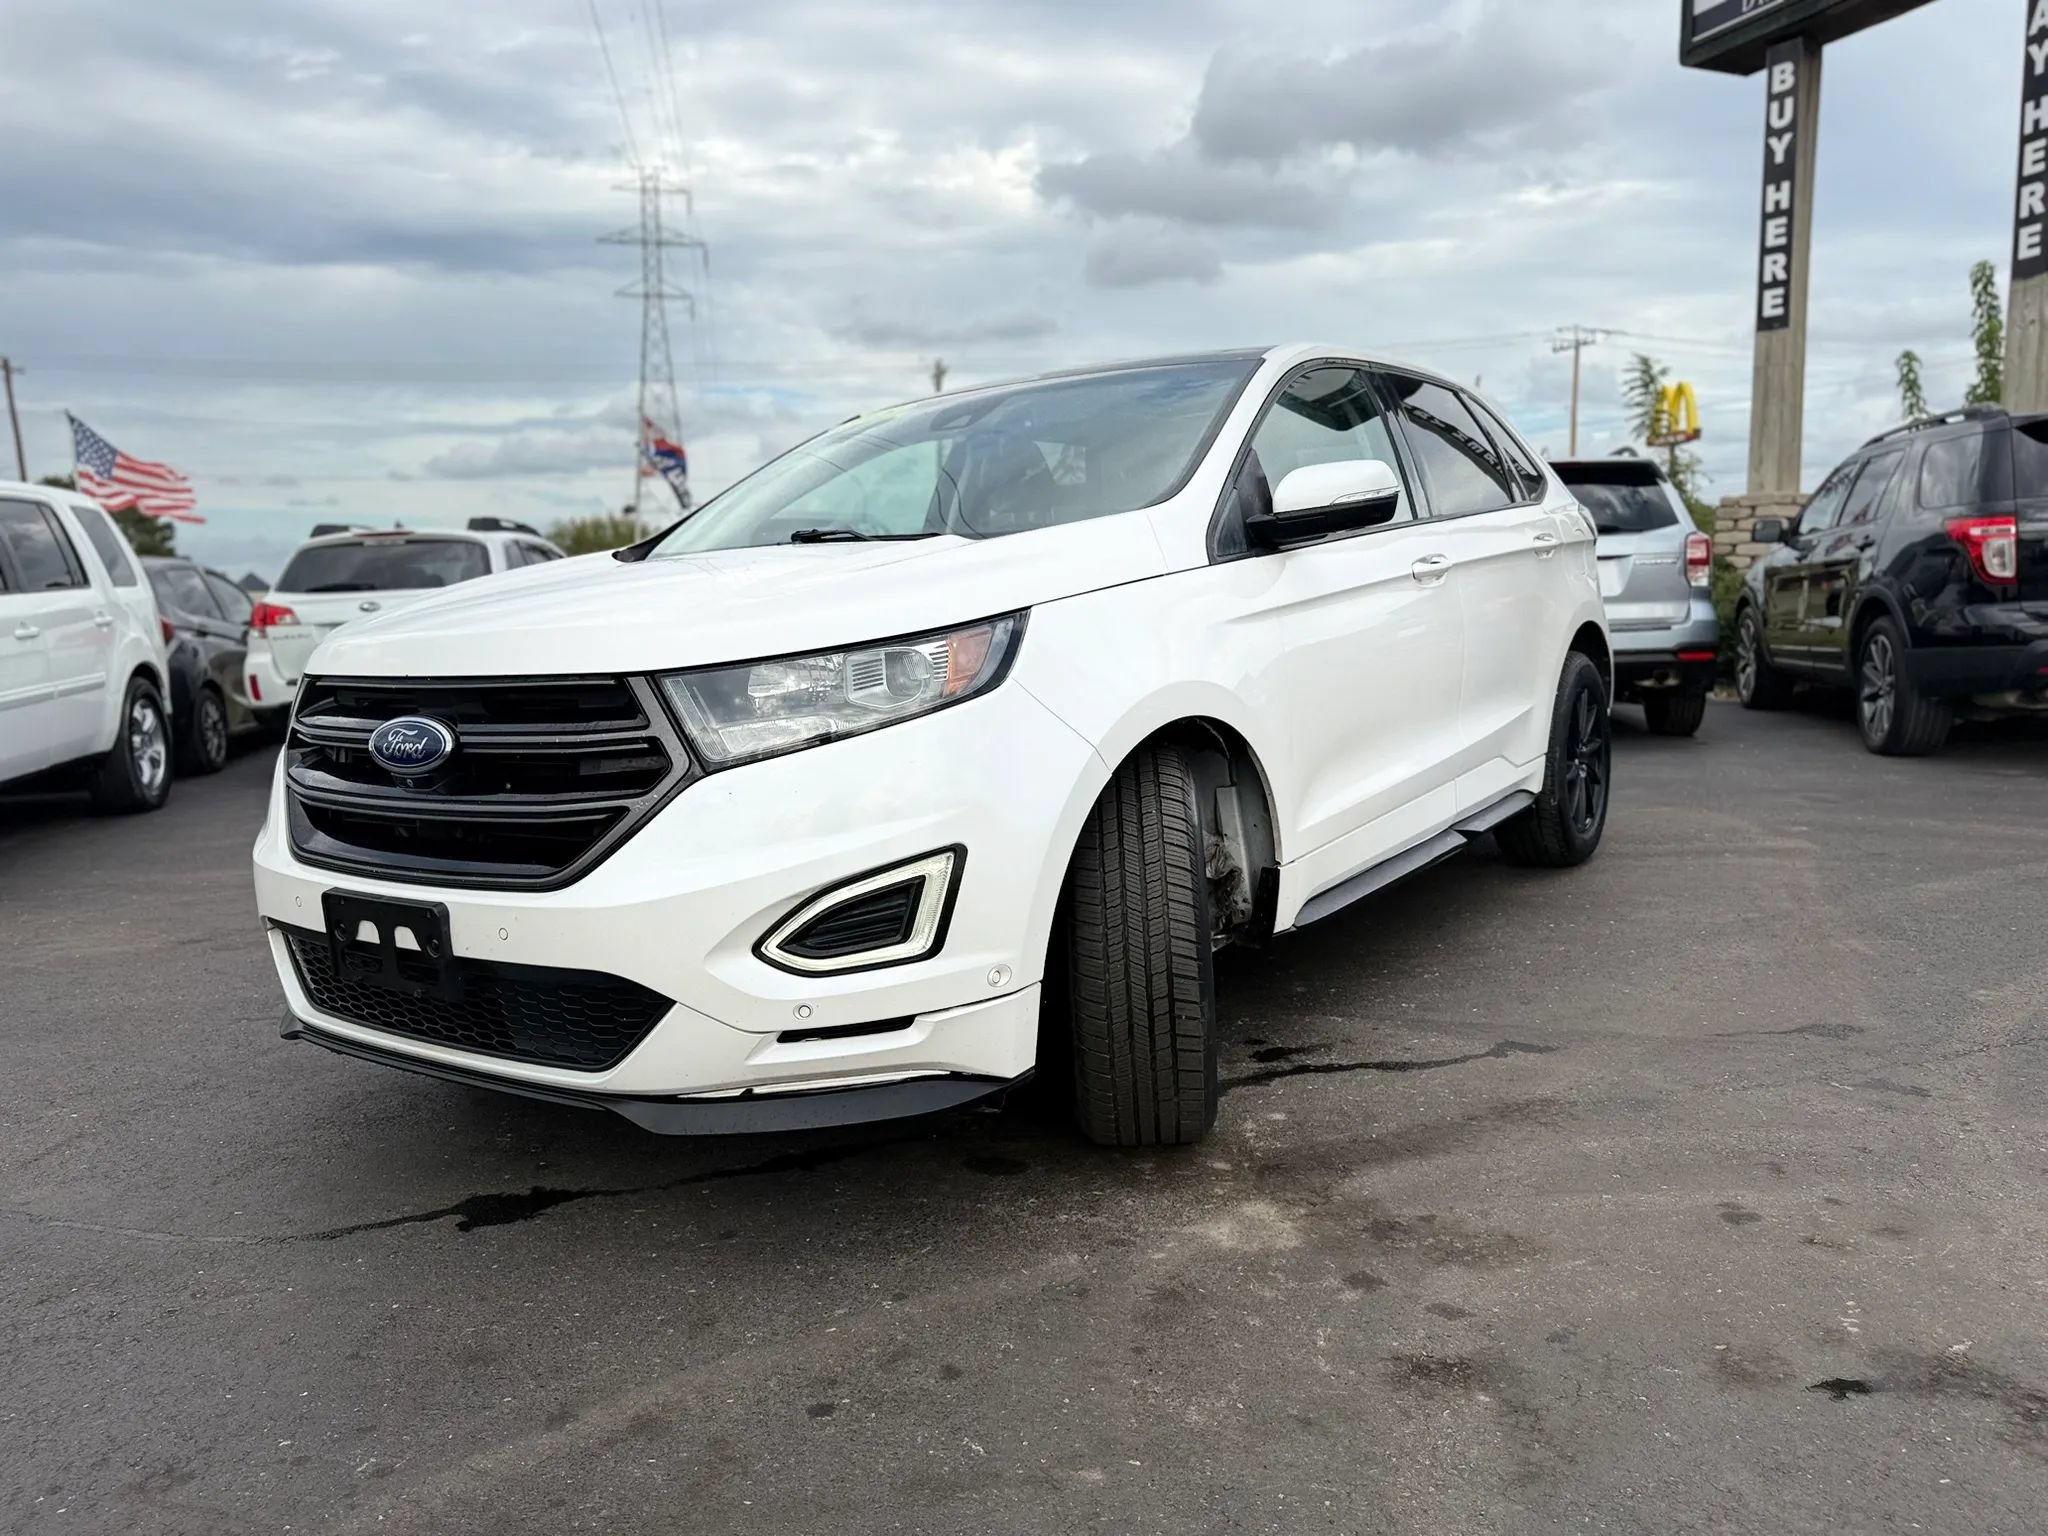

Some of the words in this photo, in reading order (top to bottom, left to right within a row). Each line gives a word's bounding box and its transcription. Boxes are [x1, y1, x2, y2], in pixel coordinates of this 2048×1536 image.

[1768, 60, 1795, 165] BUY
[2017, 95, 2048, 261] HERE
[1761, 180, 1791, 319] HERE
[382, 728, 429, 760] Ford
